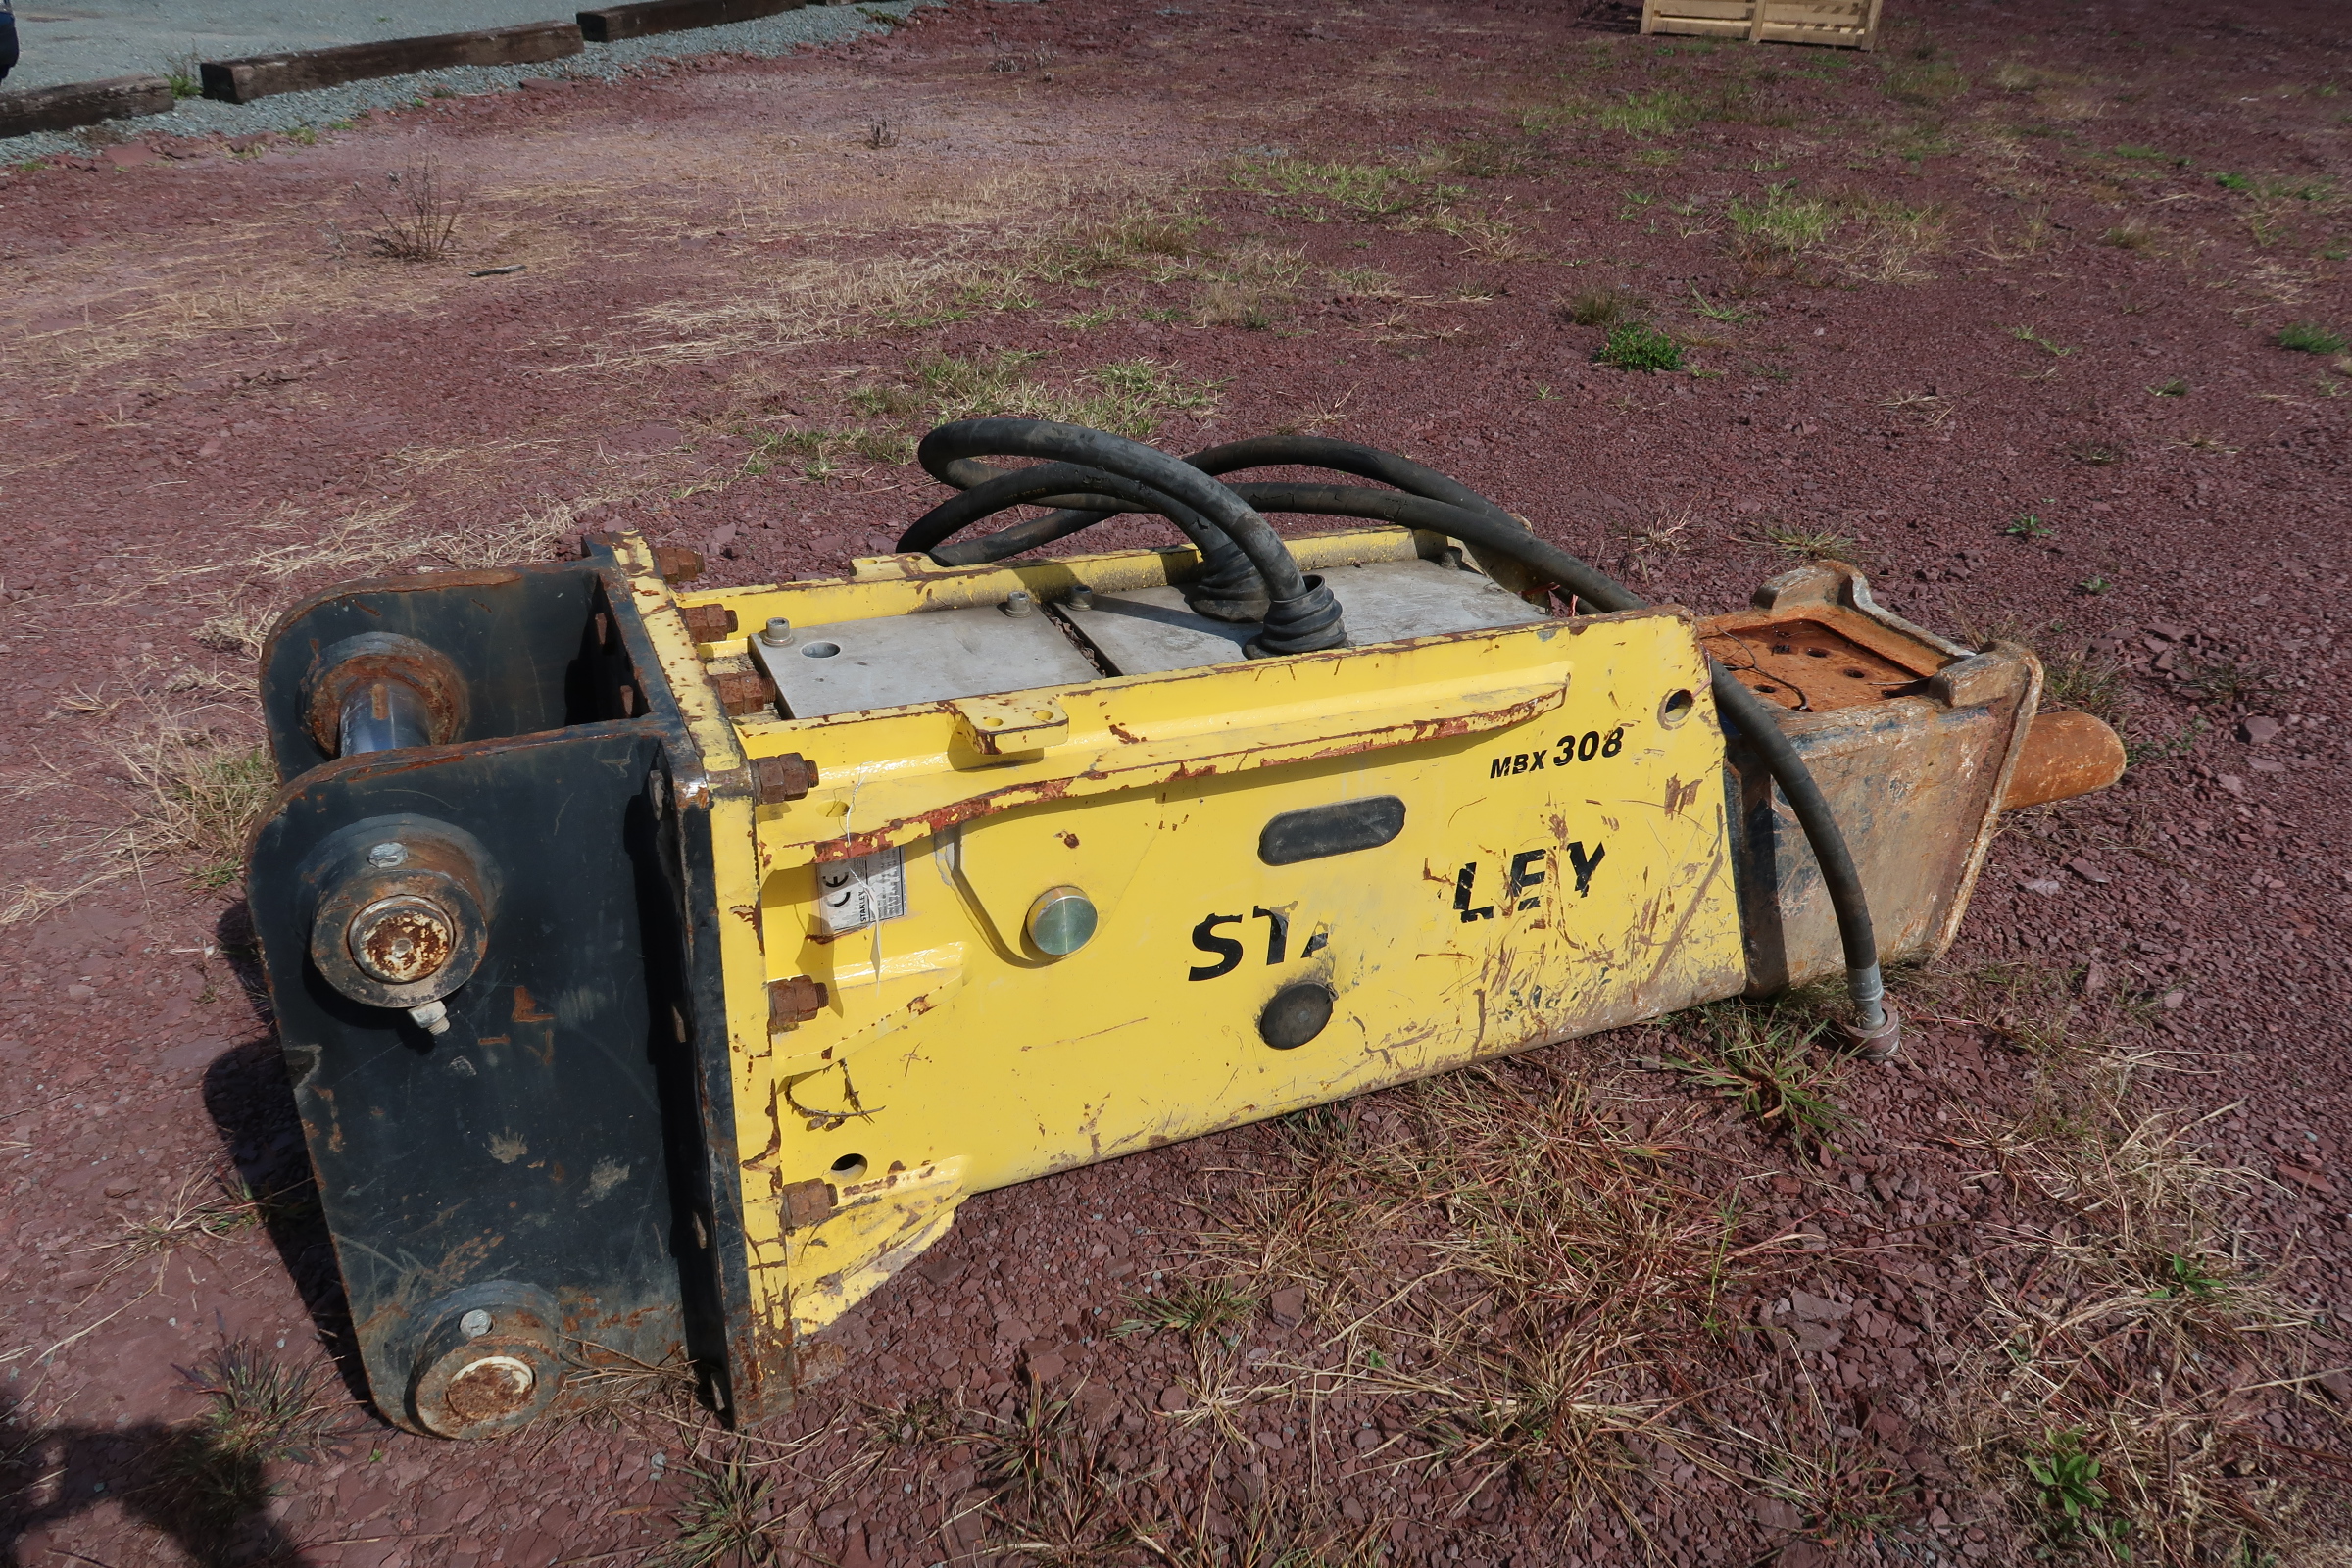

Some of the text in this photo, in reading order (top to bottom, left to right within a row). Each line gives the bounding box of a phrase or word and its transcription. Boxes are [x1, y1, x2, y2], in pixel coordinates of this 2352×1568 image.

[1489, 726, 1625, 779] MBX 308
[1188, 840, 1606, 982] STLEY
